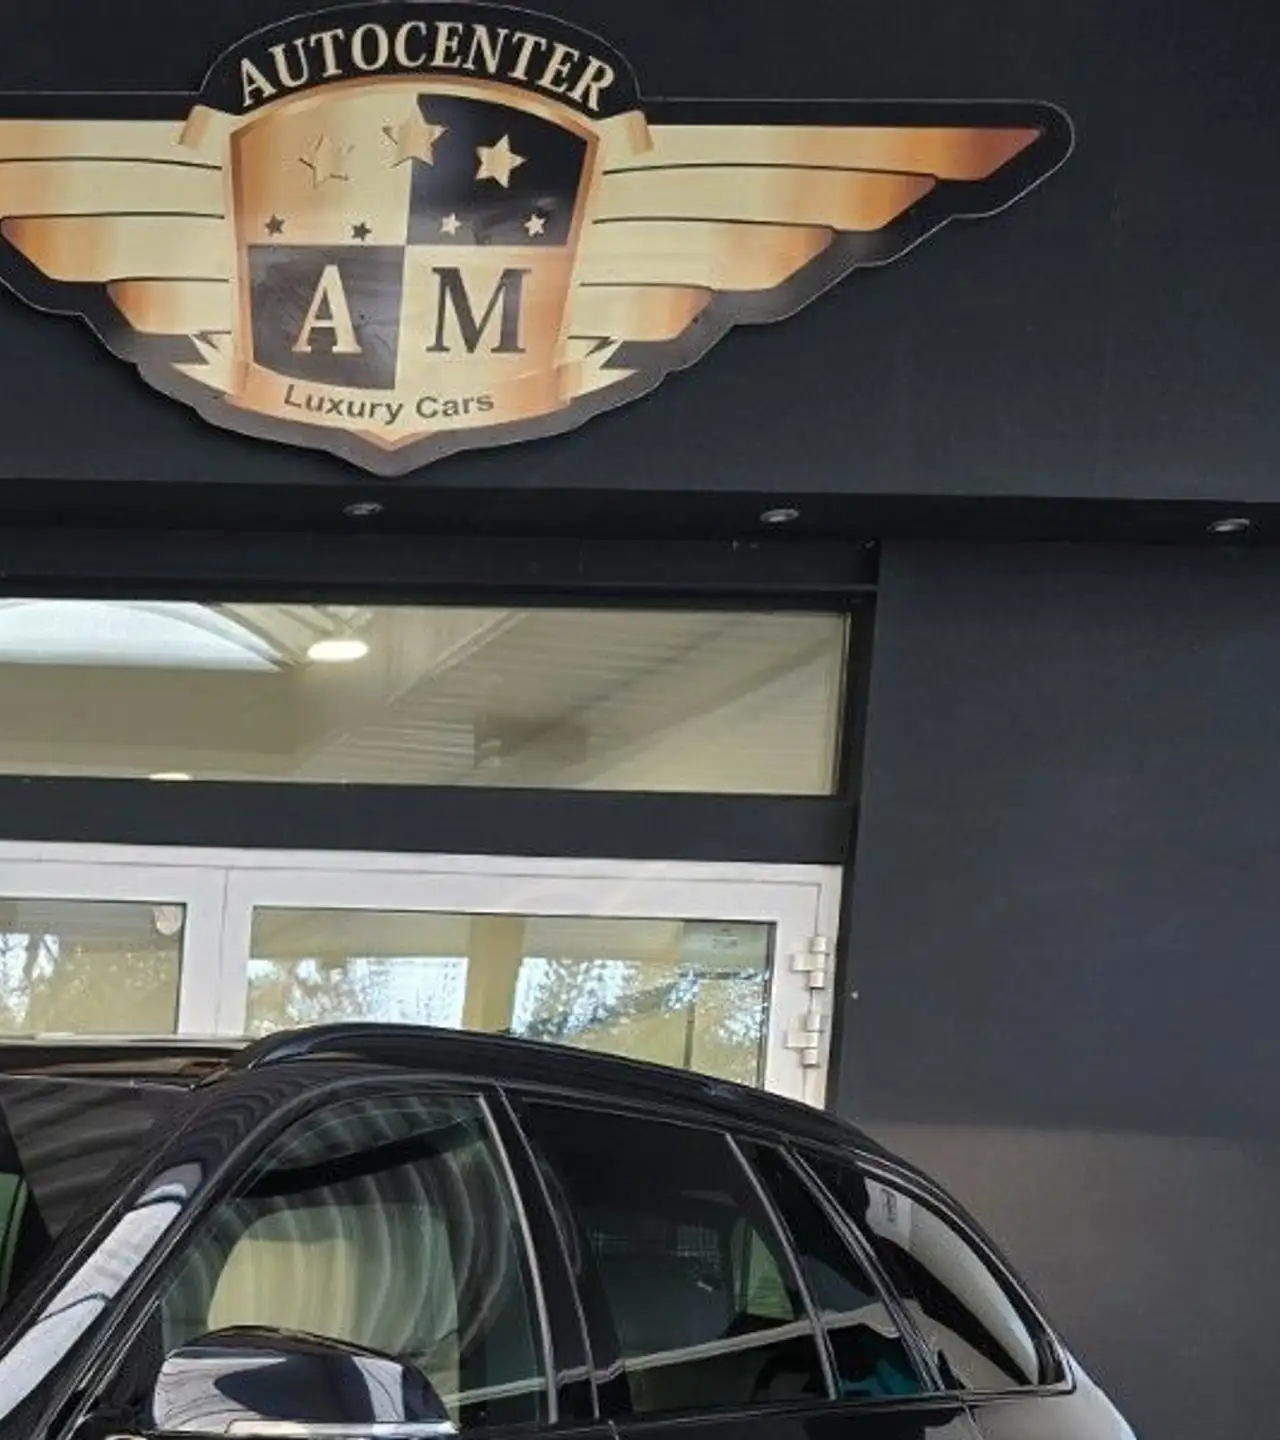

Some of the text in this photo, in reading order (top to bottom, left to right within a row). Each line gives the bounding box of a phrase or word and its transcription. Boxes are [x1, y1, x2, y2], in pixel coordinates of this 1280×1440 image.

[239, 19, 615, 111] AUTOCENTER
[291, 263, 532, 355] A M
[283, 383, 495, 425] Luxury Cars
